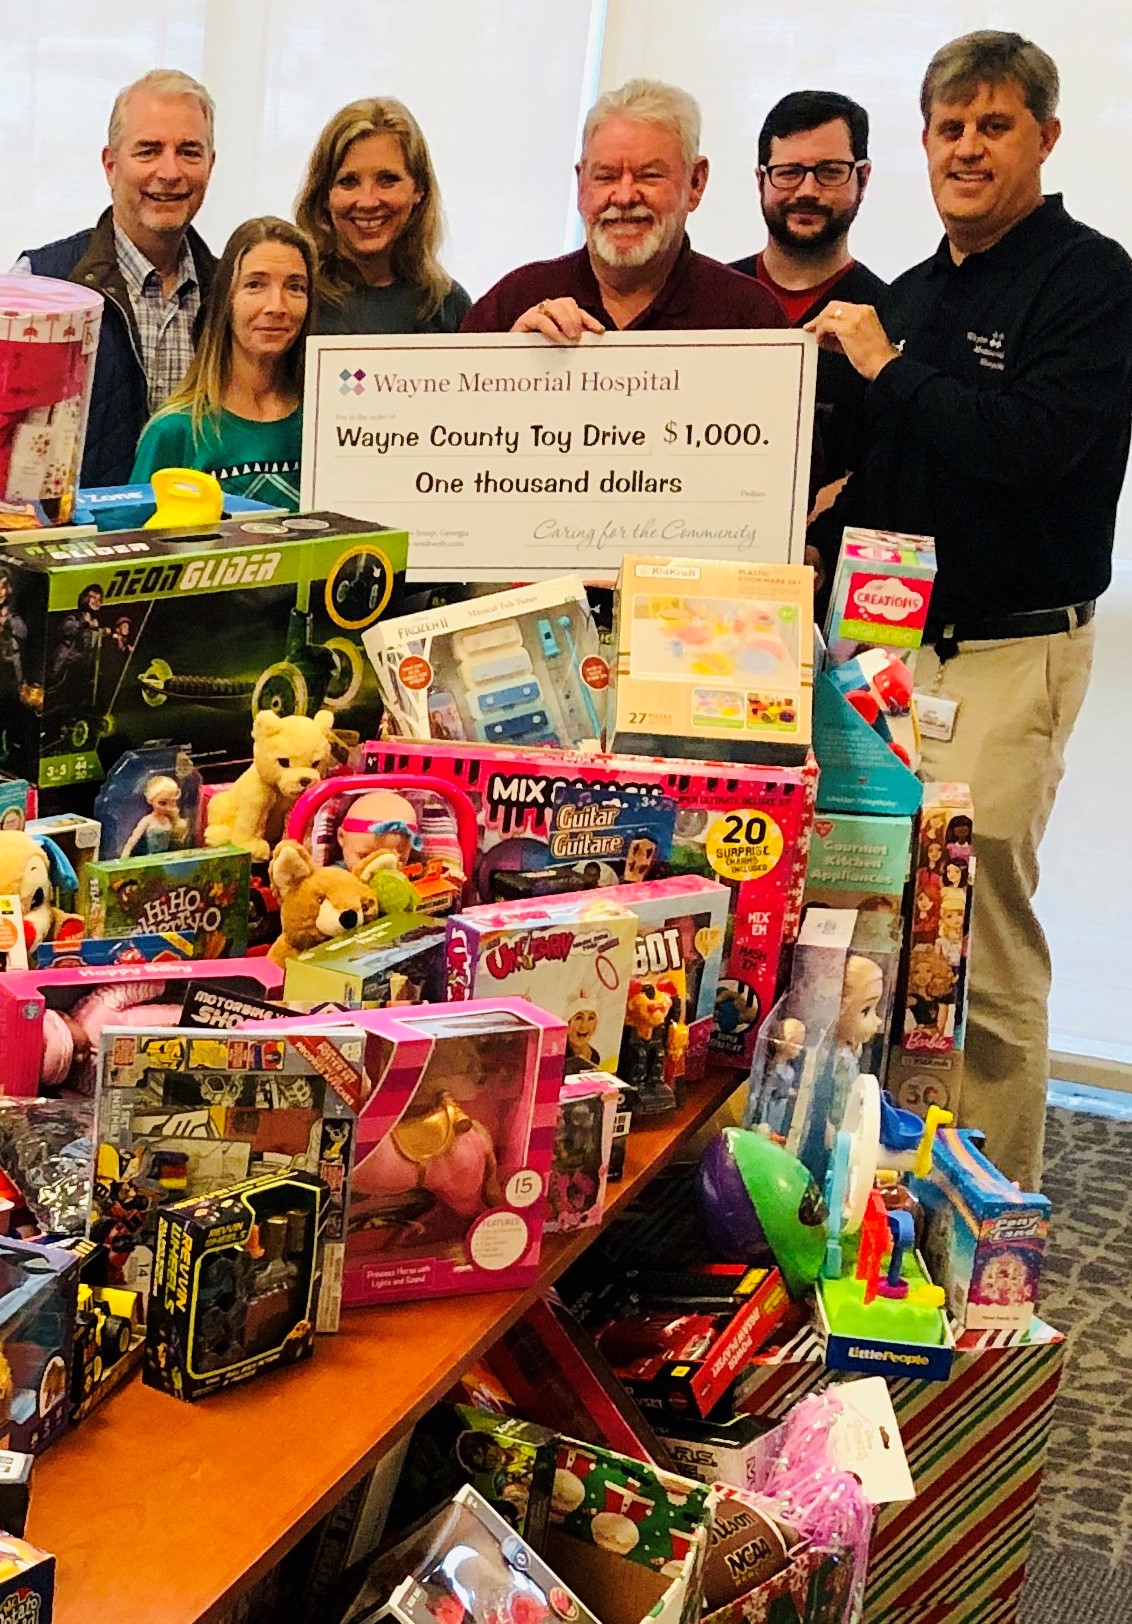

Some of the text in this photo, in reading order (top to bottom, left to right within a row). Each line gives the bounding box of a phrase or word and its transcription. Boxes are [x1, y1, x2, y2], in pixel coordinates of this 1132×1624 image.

[373, 370, 680, 398] Wayne Memorial Hospital
[336, 425, 420, 454] Wayne
[430, 425, 519, 453] County
[530, 425, 572, 453] Toy
[583, 424, 646, 446] Drive
[415, 470, 683, 493] One thousand dollars
[533, 518, 757, 551] Caring for the Community
[856, 591, 919, 608] CREATIONS
[397, 620, 439, 639] FROZEN
[629, 712, 647, 724] 27
[492, 776, 547, 804] MIX
[558, 804, 619, 829] Guitar
[722, 815, 767, 845] 20
[552, 833, 622, 857] Guitare
[716, 846, 770, 859] SURPRISE
[823, 841, 888, 855] Gourmet
[824, 855, 883, 869] Kitchen
[811, 869, 893, 884] Appliances
[905, 1029, 950, 1050] Barbie
[514, 1177, 533, 1194] 15
[164, 1222, 182, 1315] WHEELS
[176, 1231, 194, 1313] REVVIN
[723, 1535, 773, 1578] NCAA
